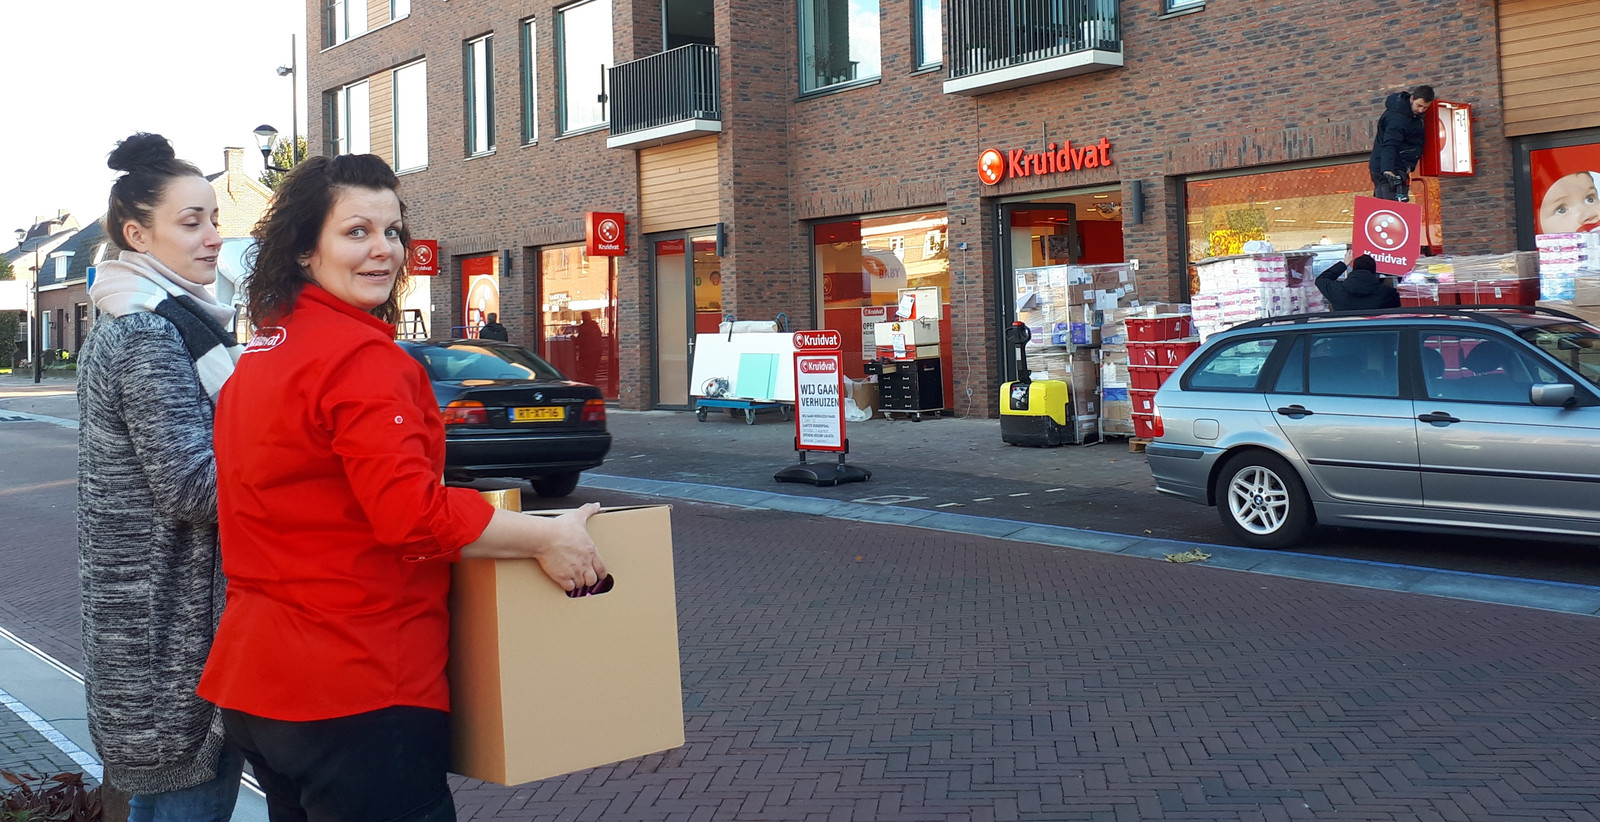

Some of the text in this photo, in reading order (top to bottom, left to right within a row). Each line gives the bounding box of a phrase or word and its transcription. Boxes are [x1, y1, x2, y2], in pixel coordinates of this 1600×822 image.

[1008, 137, 1111, 178] Kruidvat
[878, 267, 900, 279] BABY
[804, 334, 838, 346] Kruidvat
[808, 361, 836, 371] Kruidvat
[800, 384, 839, 395] WIJ GAAN
[801, 397, 840, 407] VERHUIZEN
